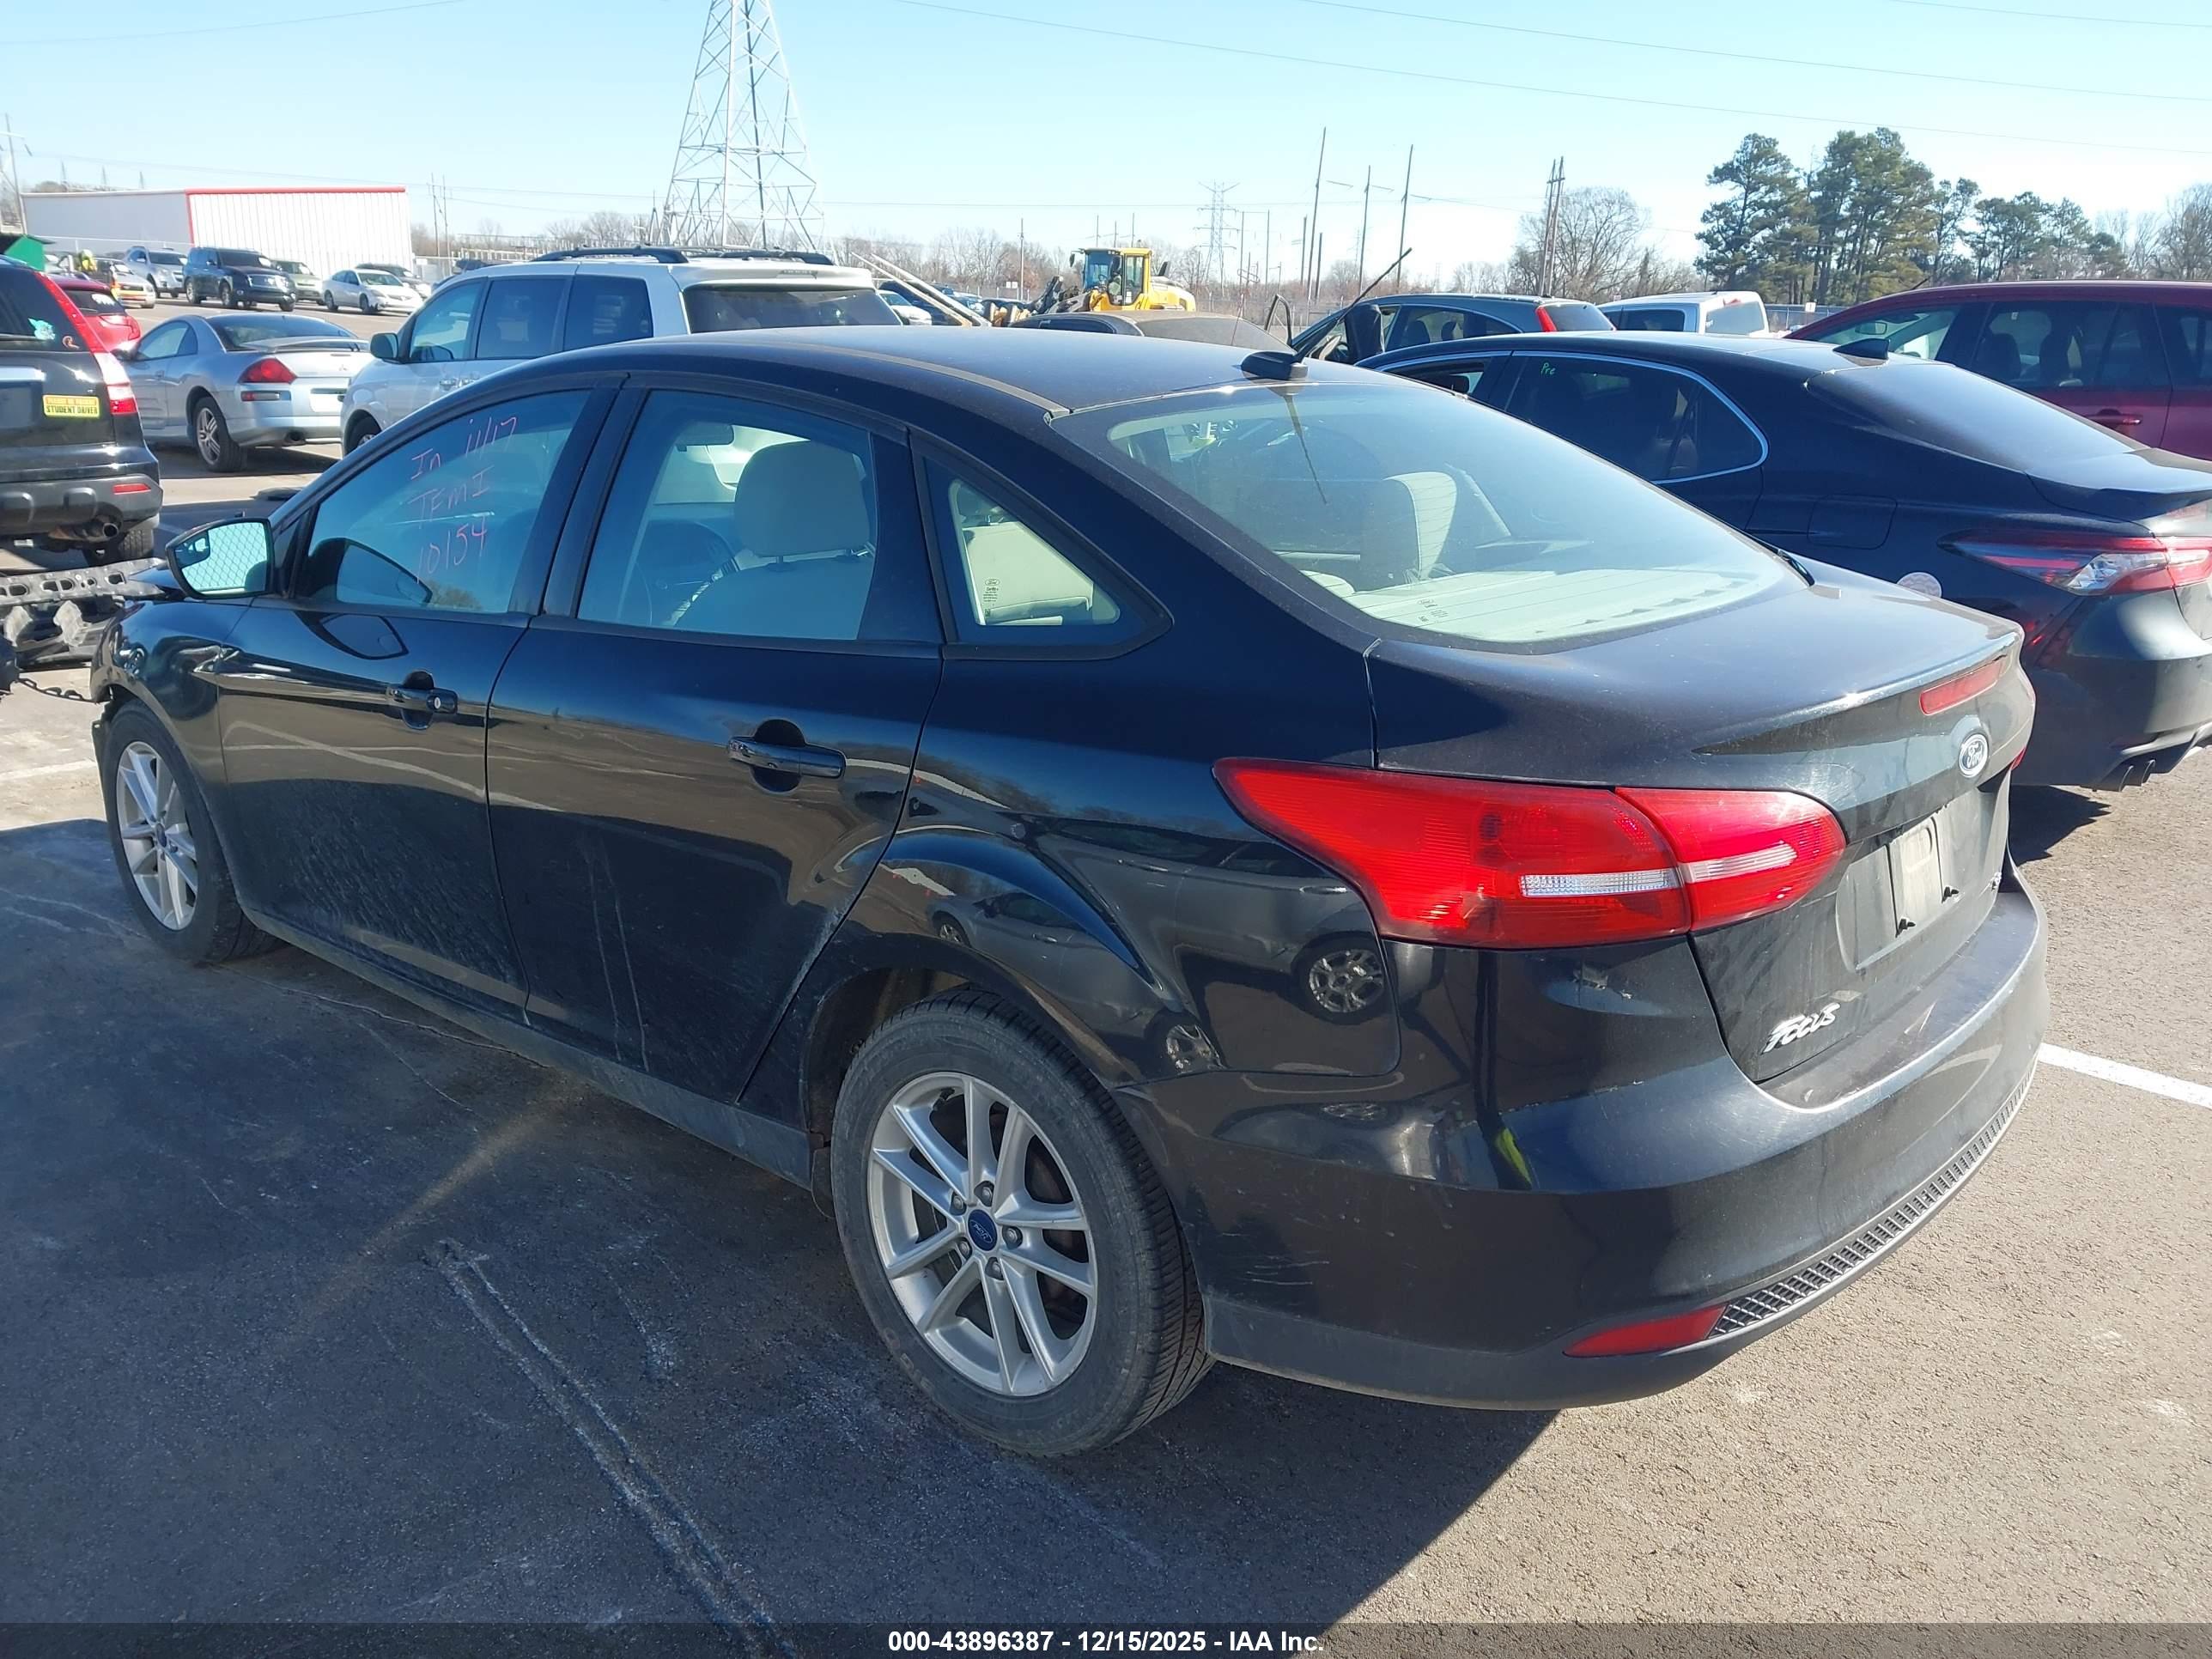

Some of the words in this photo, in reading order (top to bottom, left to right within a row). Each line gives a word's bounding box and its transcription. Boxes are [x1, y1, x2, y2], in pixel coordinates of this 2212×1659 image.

[1540, 362, 1557, 376] Pre
[46, 405, 76, 414] STUDENT
[77, 406, 98, 415] DRIVER
[415, 515, 488, 585] 10154
